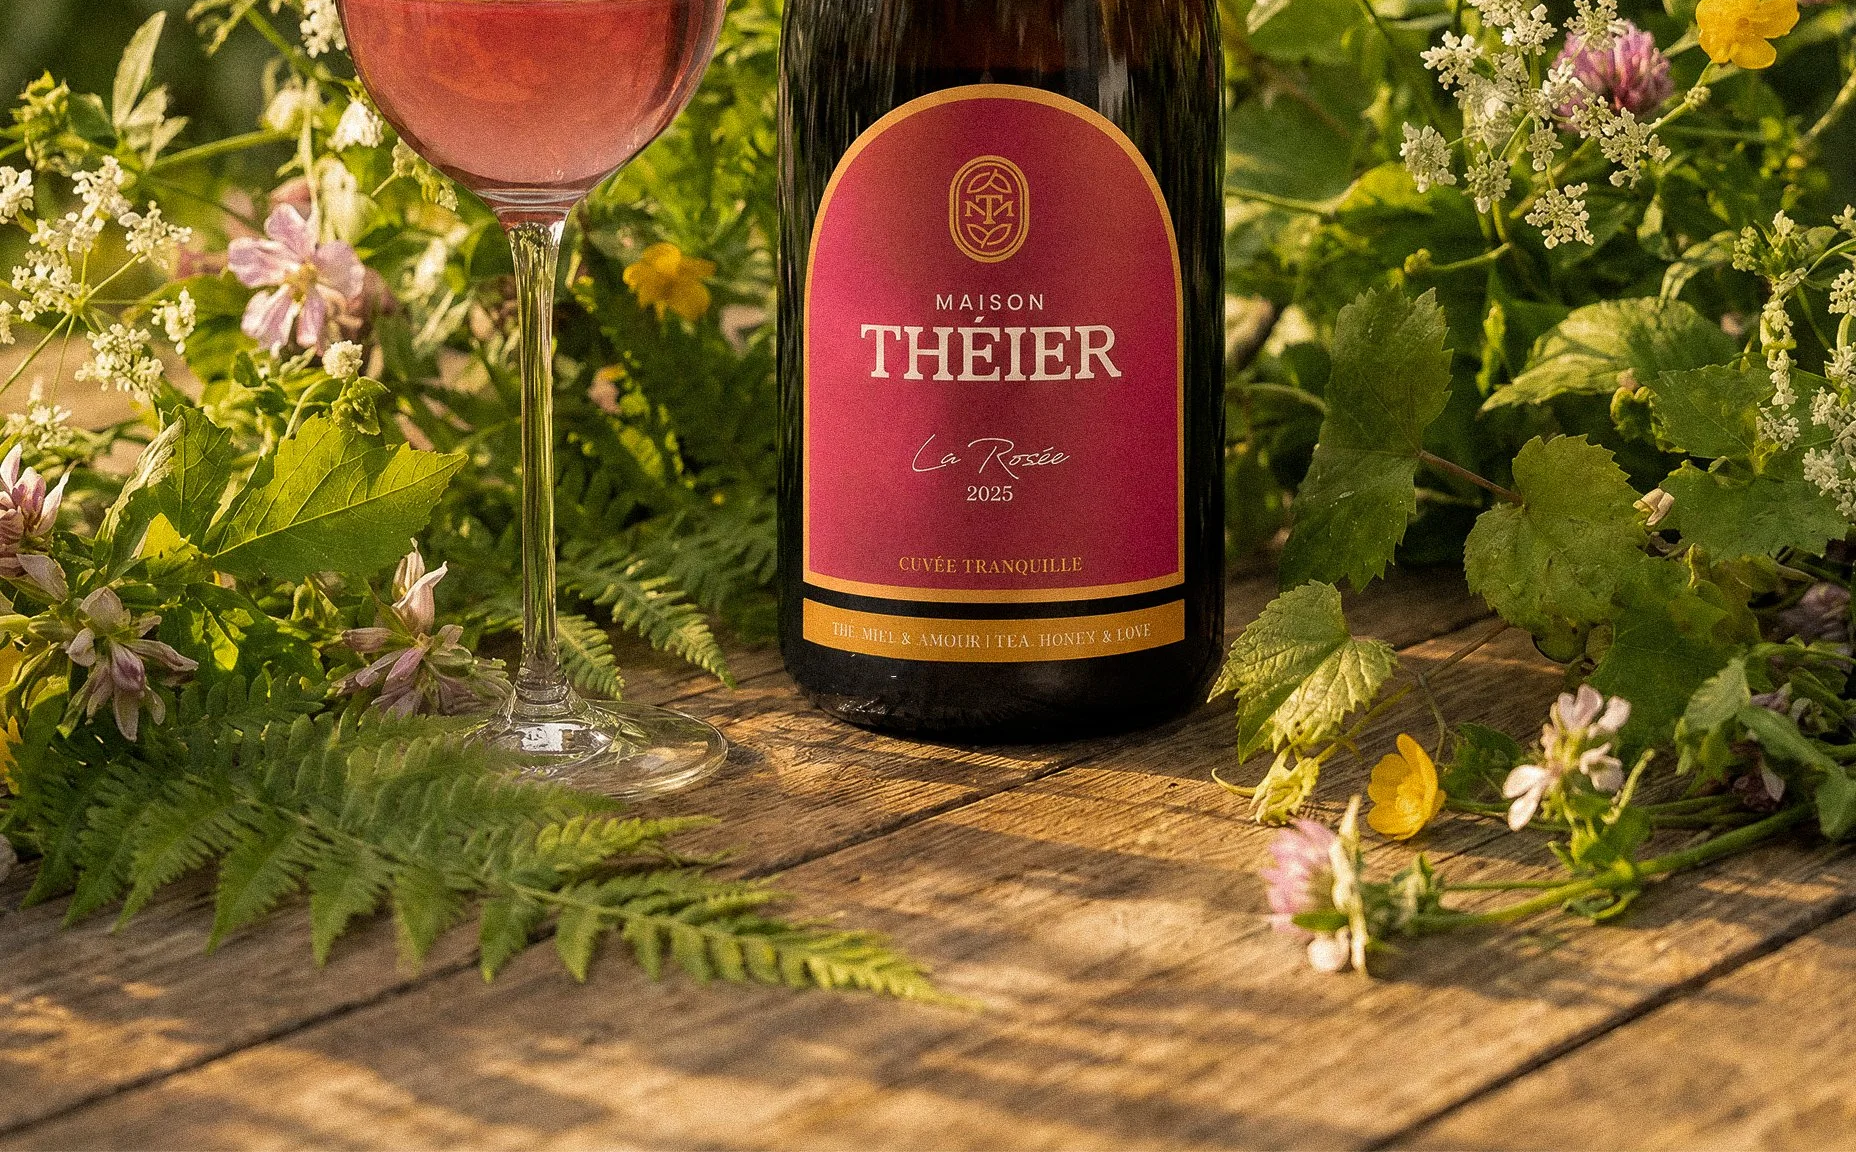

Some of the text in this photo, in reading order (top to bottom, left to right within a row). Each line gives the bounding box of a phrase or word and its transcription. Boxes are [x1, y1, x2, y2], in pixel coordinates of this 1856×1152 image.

[935, 294, 1044, 311] MAISON
[860, 315, 1122, 382] THÉIER
[912, 433, 1070, 480] La Rosée
[966, 485, 1013, 502] 2025
[899, 555, 1082, 576] CUVÉE TRANQUILLE
[901, 632, 911, 645] &
[917, 633, 980, 648] AMOUR
[1040, 630, 1097, 647] HONEY
[1102, 630, 1112, 643] &
[1116, 623, 1151, 641] LOVE
